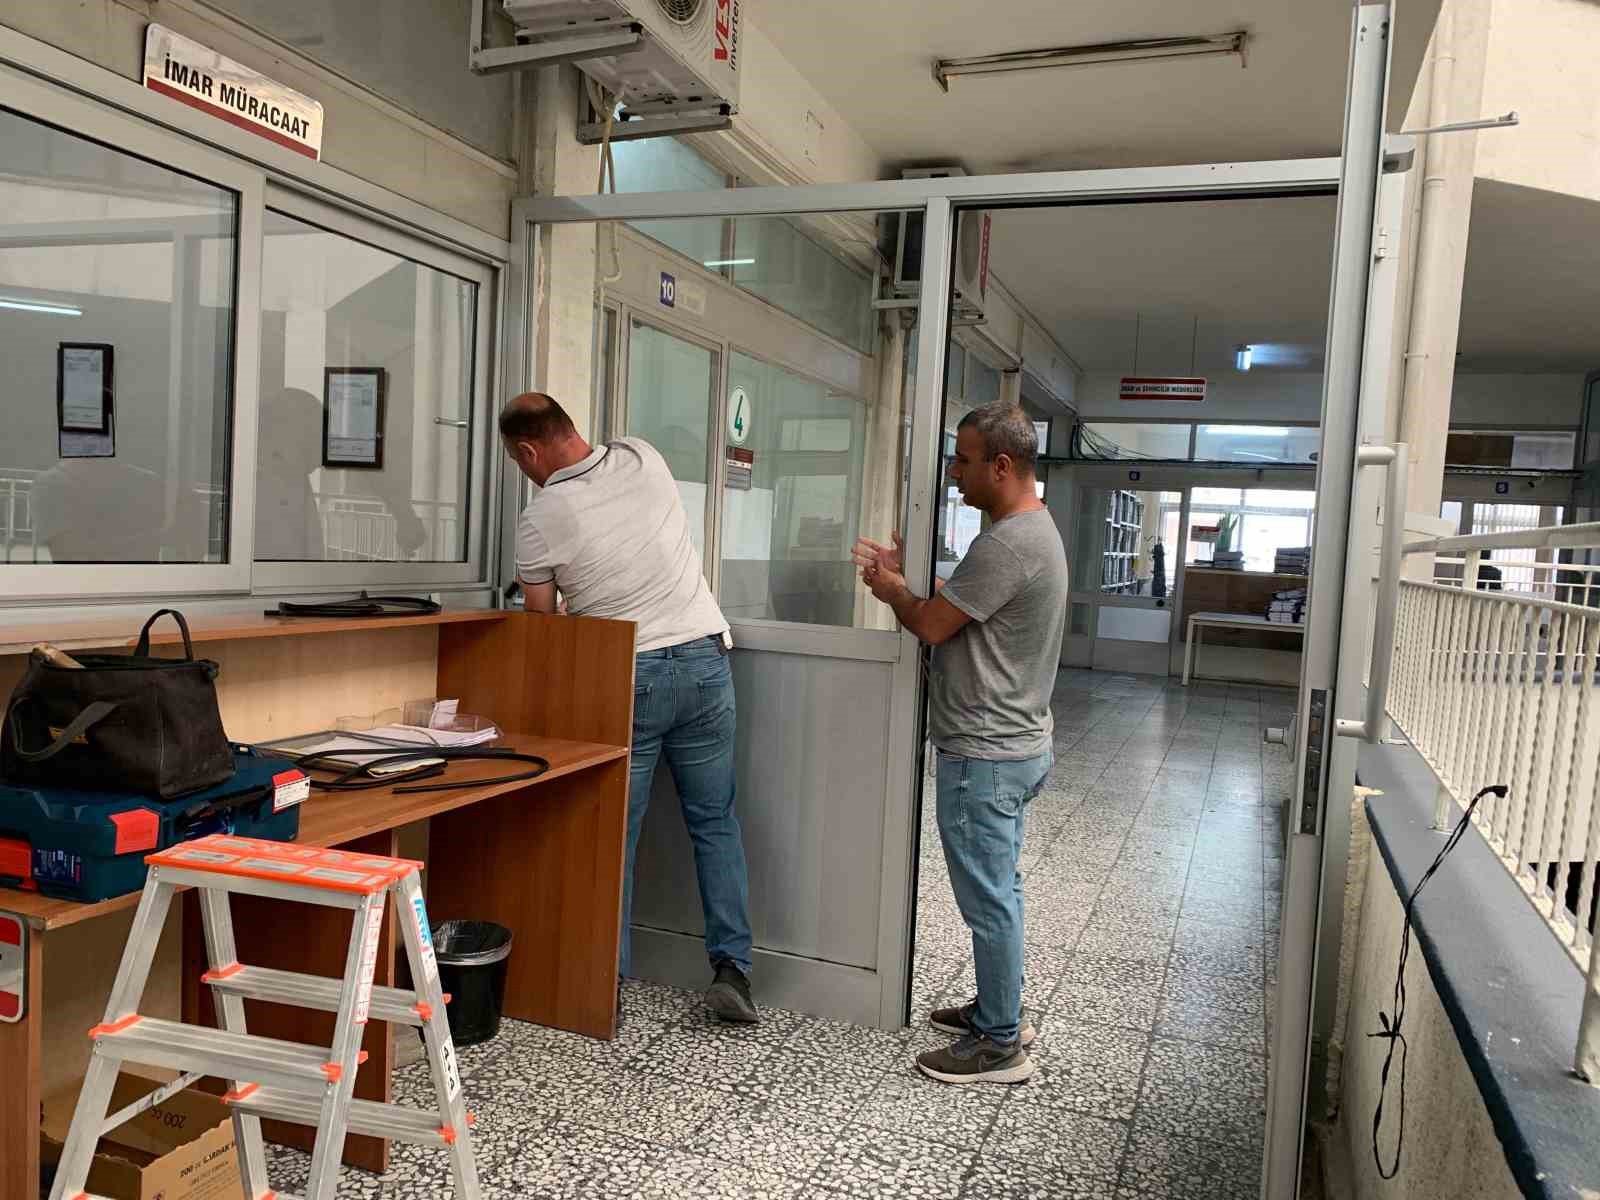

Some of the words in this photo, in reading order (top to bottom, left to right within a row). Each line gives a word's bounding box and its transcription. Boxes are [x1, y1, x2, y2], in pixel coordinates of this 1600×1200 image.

[164, 52, 214, 98] İMAR
[219, 81, 310, 140] MÜRACAAT
[661, 279, 674, 301] 10
[734, 394, 744, 437] 4
